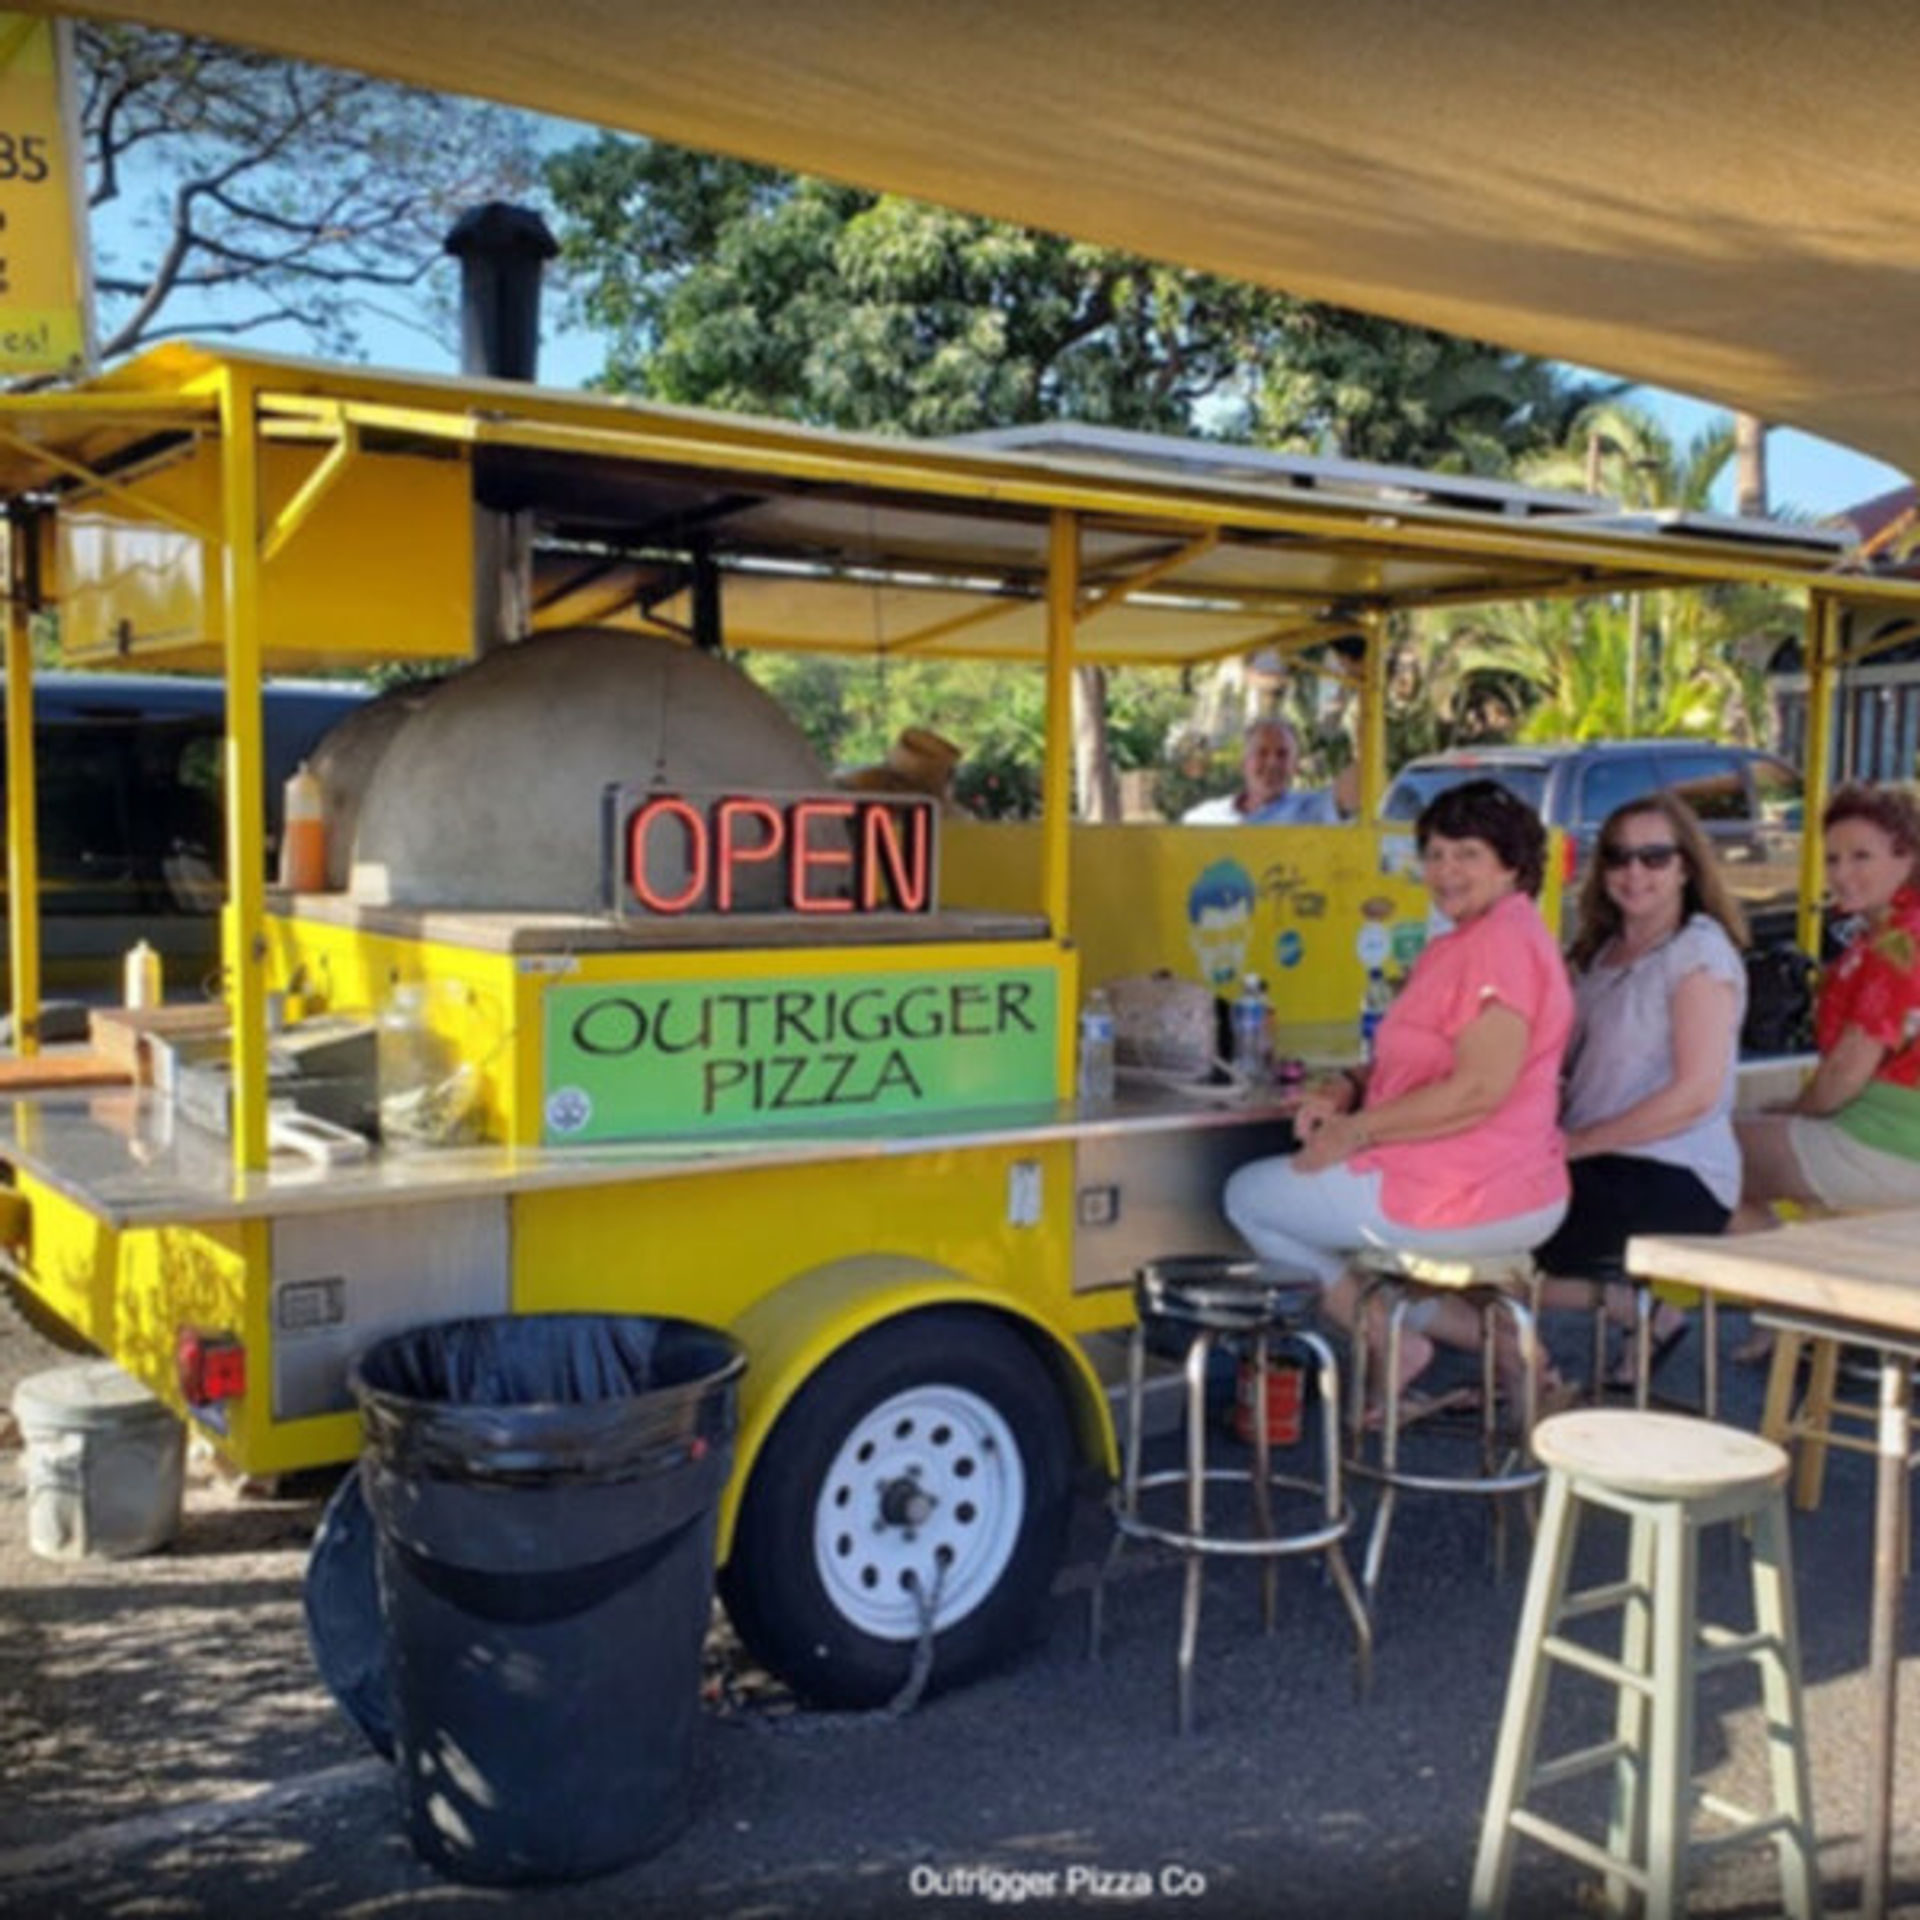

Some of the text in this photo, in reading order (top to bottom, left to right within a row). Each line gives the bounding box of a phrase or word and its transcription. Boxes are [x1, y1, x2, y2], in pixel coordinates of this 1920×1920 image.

[629, 798, 926, 913] OPEN
[572, 981, 1037, 1055] OUTRIGGER
[703, 1050, 923, 1113] PIZZA
